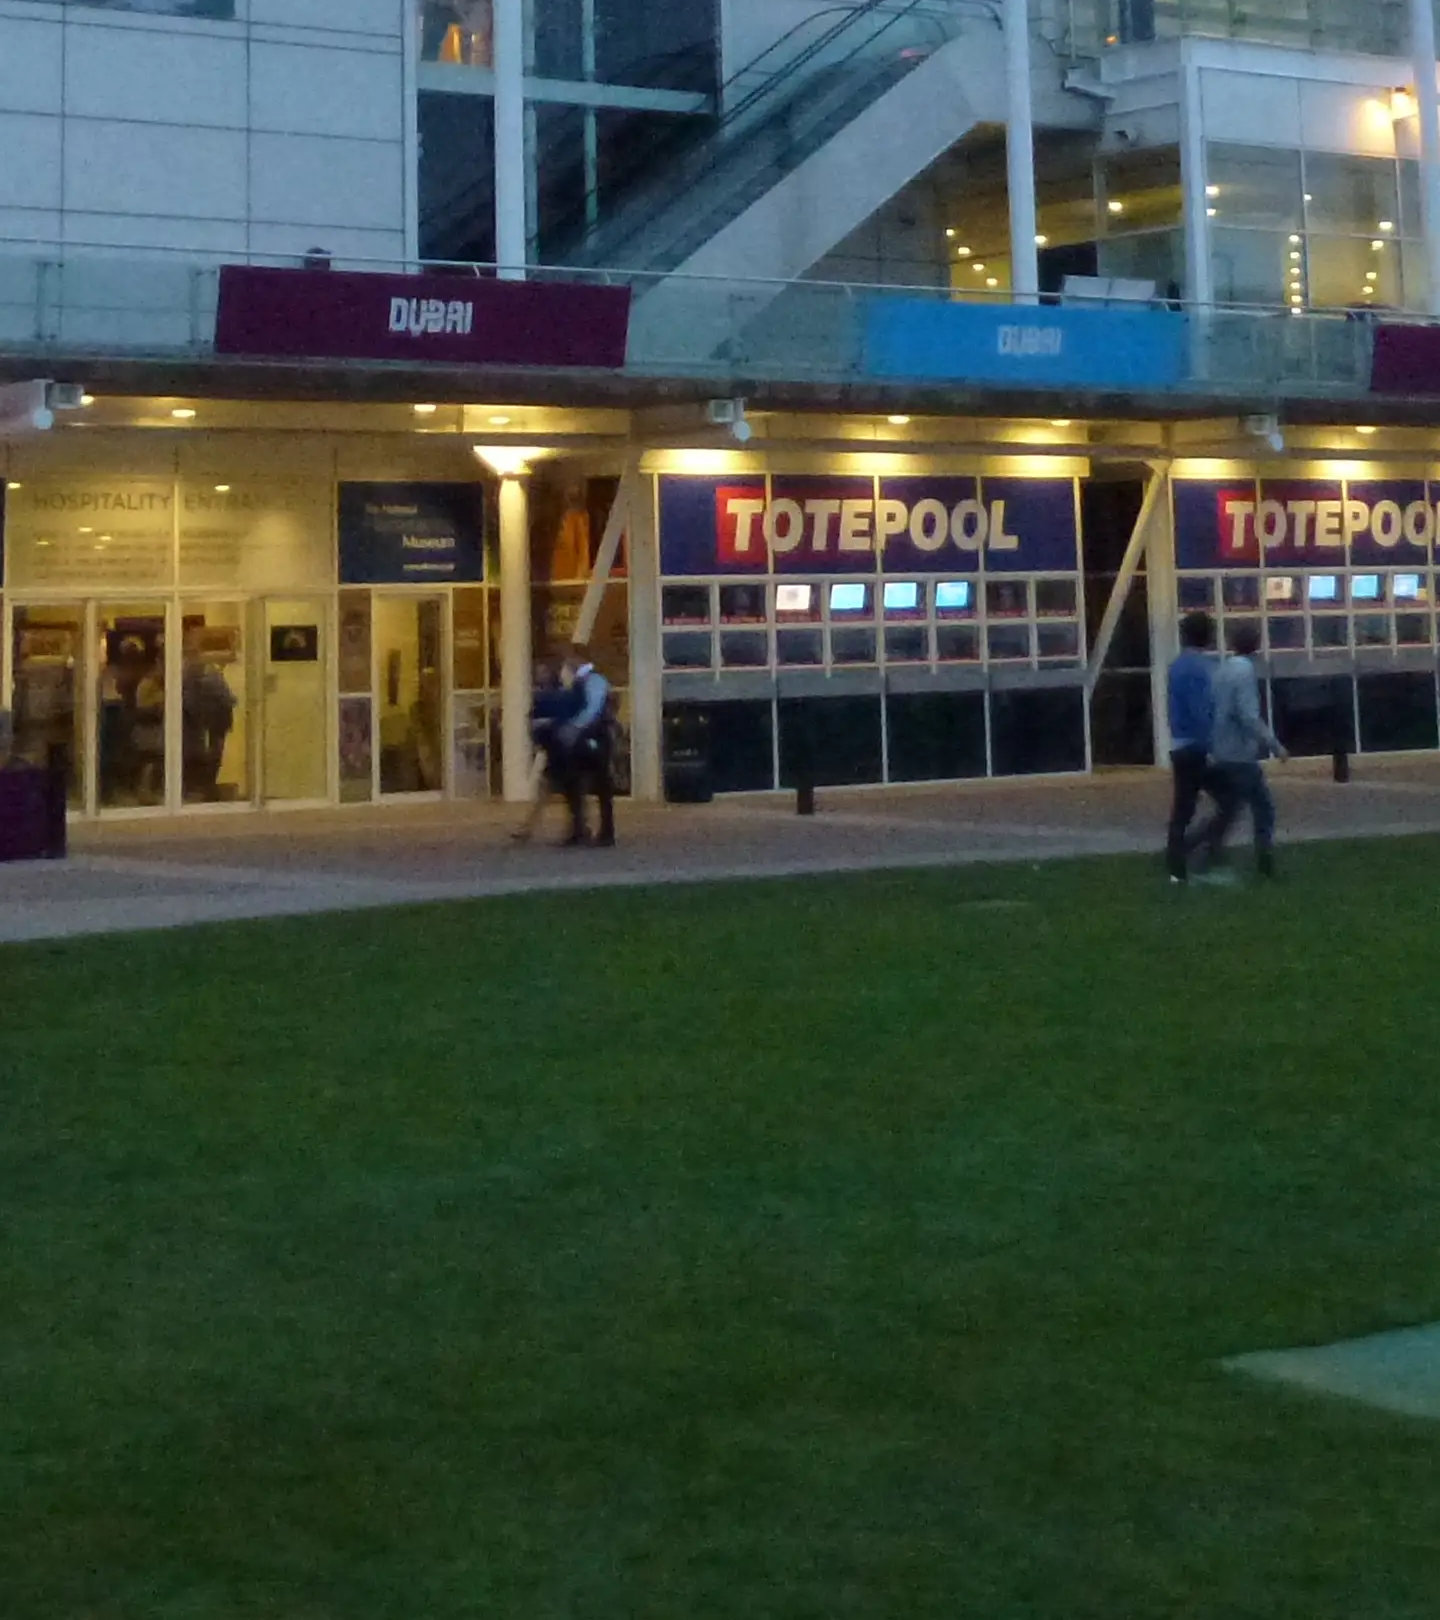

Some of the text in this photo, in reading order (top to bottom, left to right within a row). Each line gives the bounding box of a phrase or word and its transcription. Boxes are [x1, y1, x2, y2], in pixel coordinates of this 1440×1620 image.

[389, 297, 474, 337] DUBAI
[33, 490, 295, 512] HOSPITALITY ENTRAE
[726, 498, 1019, 552] TOTEPOOL
[402, 533, 456, 549] Museum
